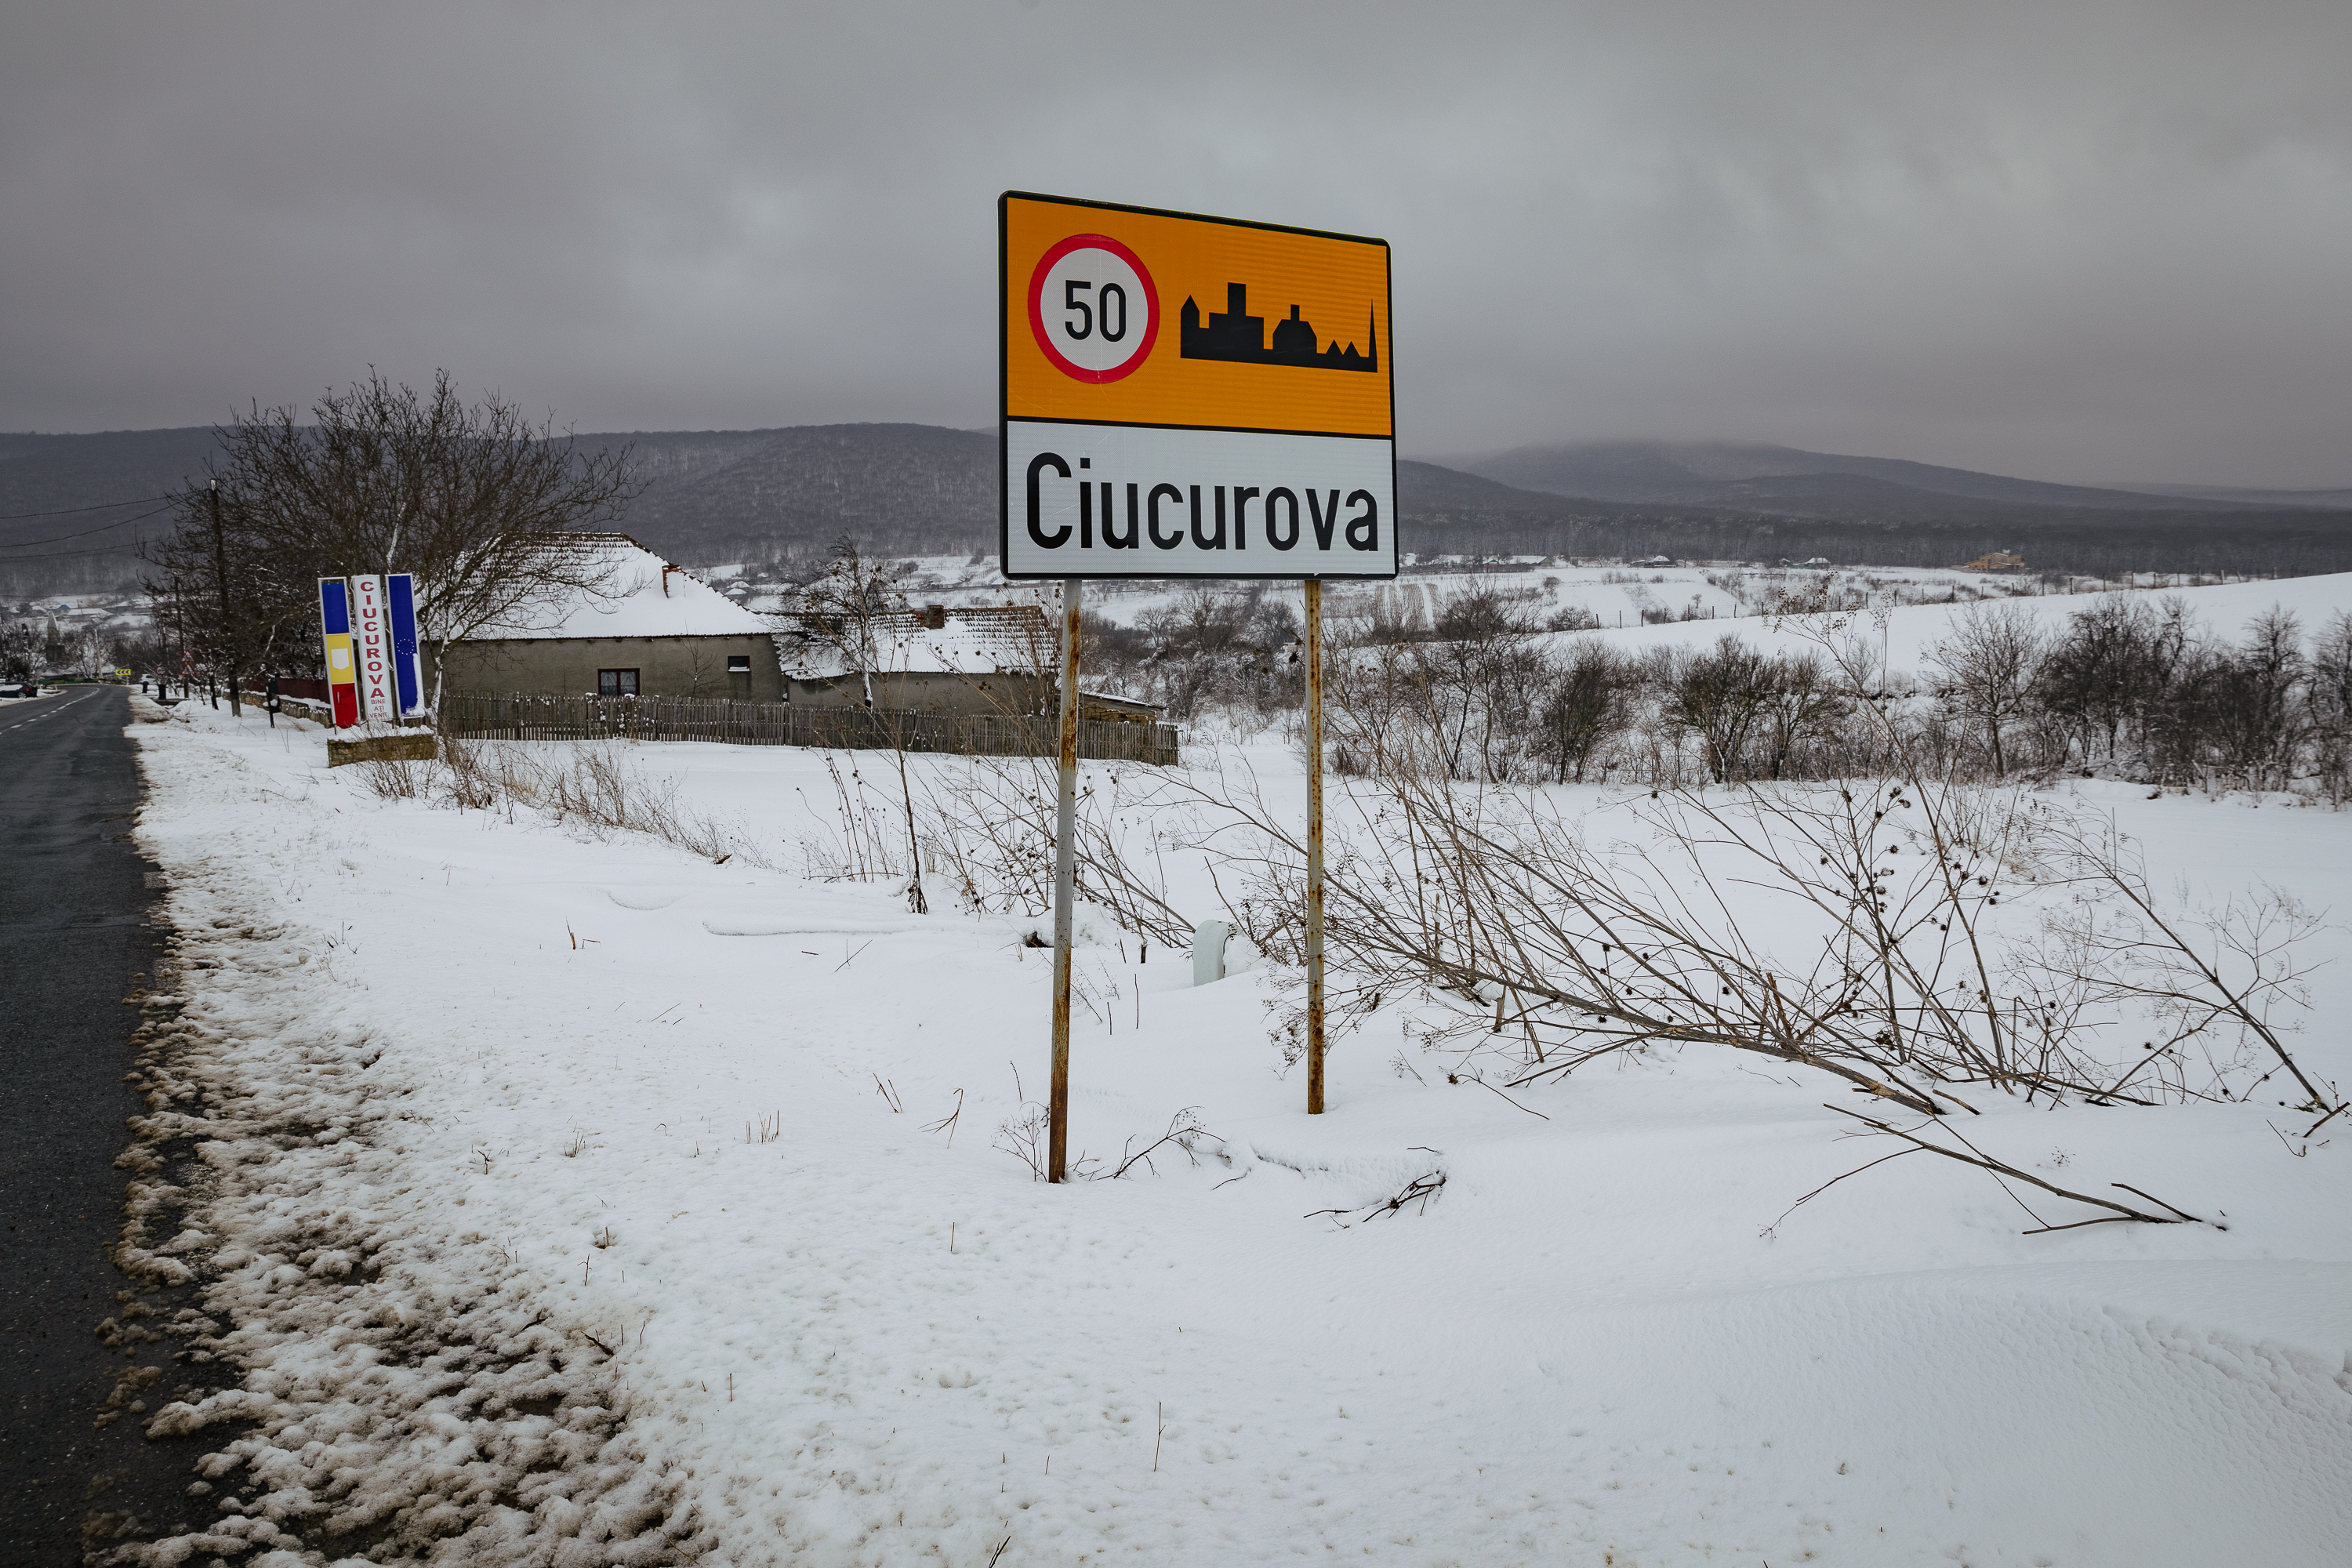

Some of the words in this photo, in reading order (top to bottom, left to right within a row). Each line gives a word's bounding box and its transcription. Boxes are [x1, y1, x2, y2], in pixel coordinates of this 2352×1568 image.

[1065, 279, 1127, 343] 50
[1026, 452, 1379, 552] Ciucurova
[360, 581, 385, 699] CIUCUROVA
